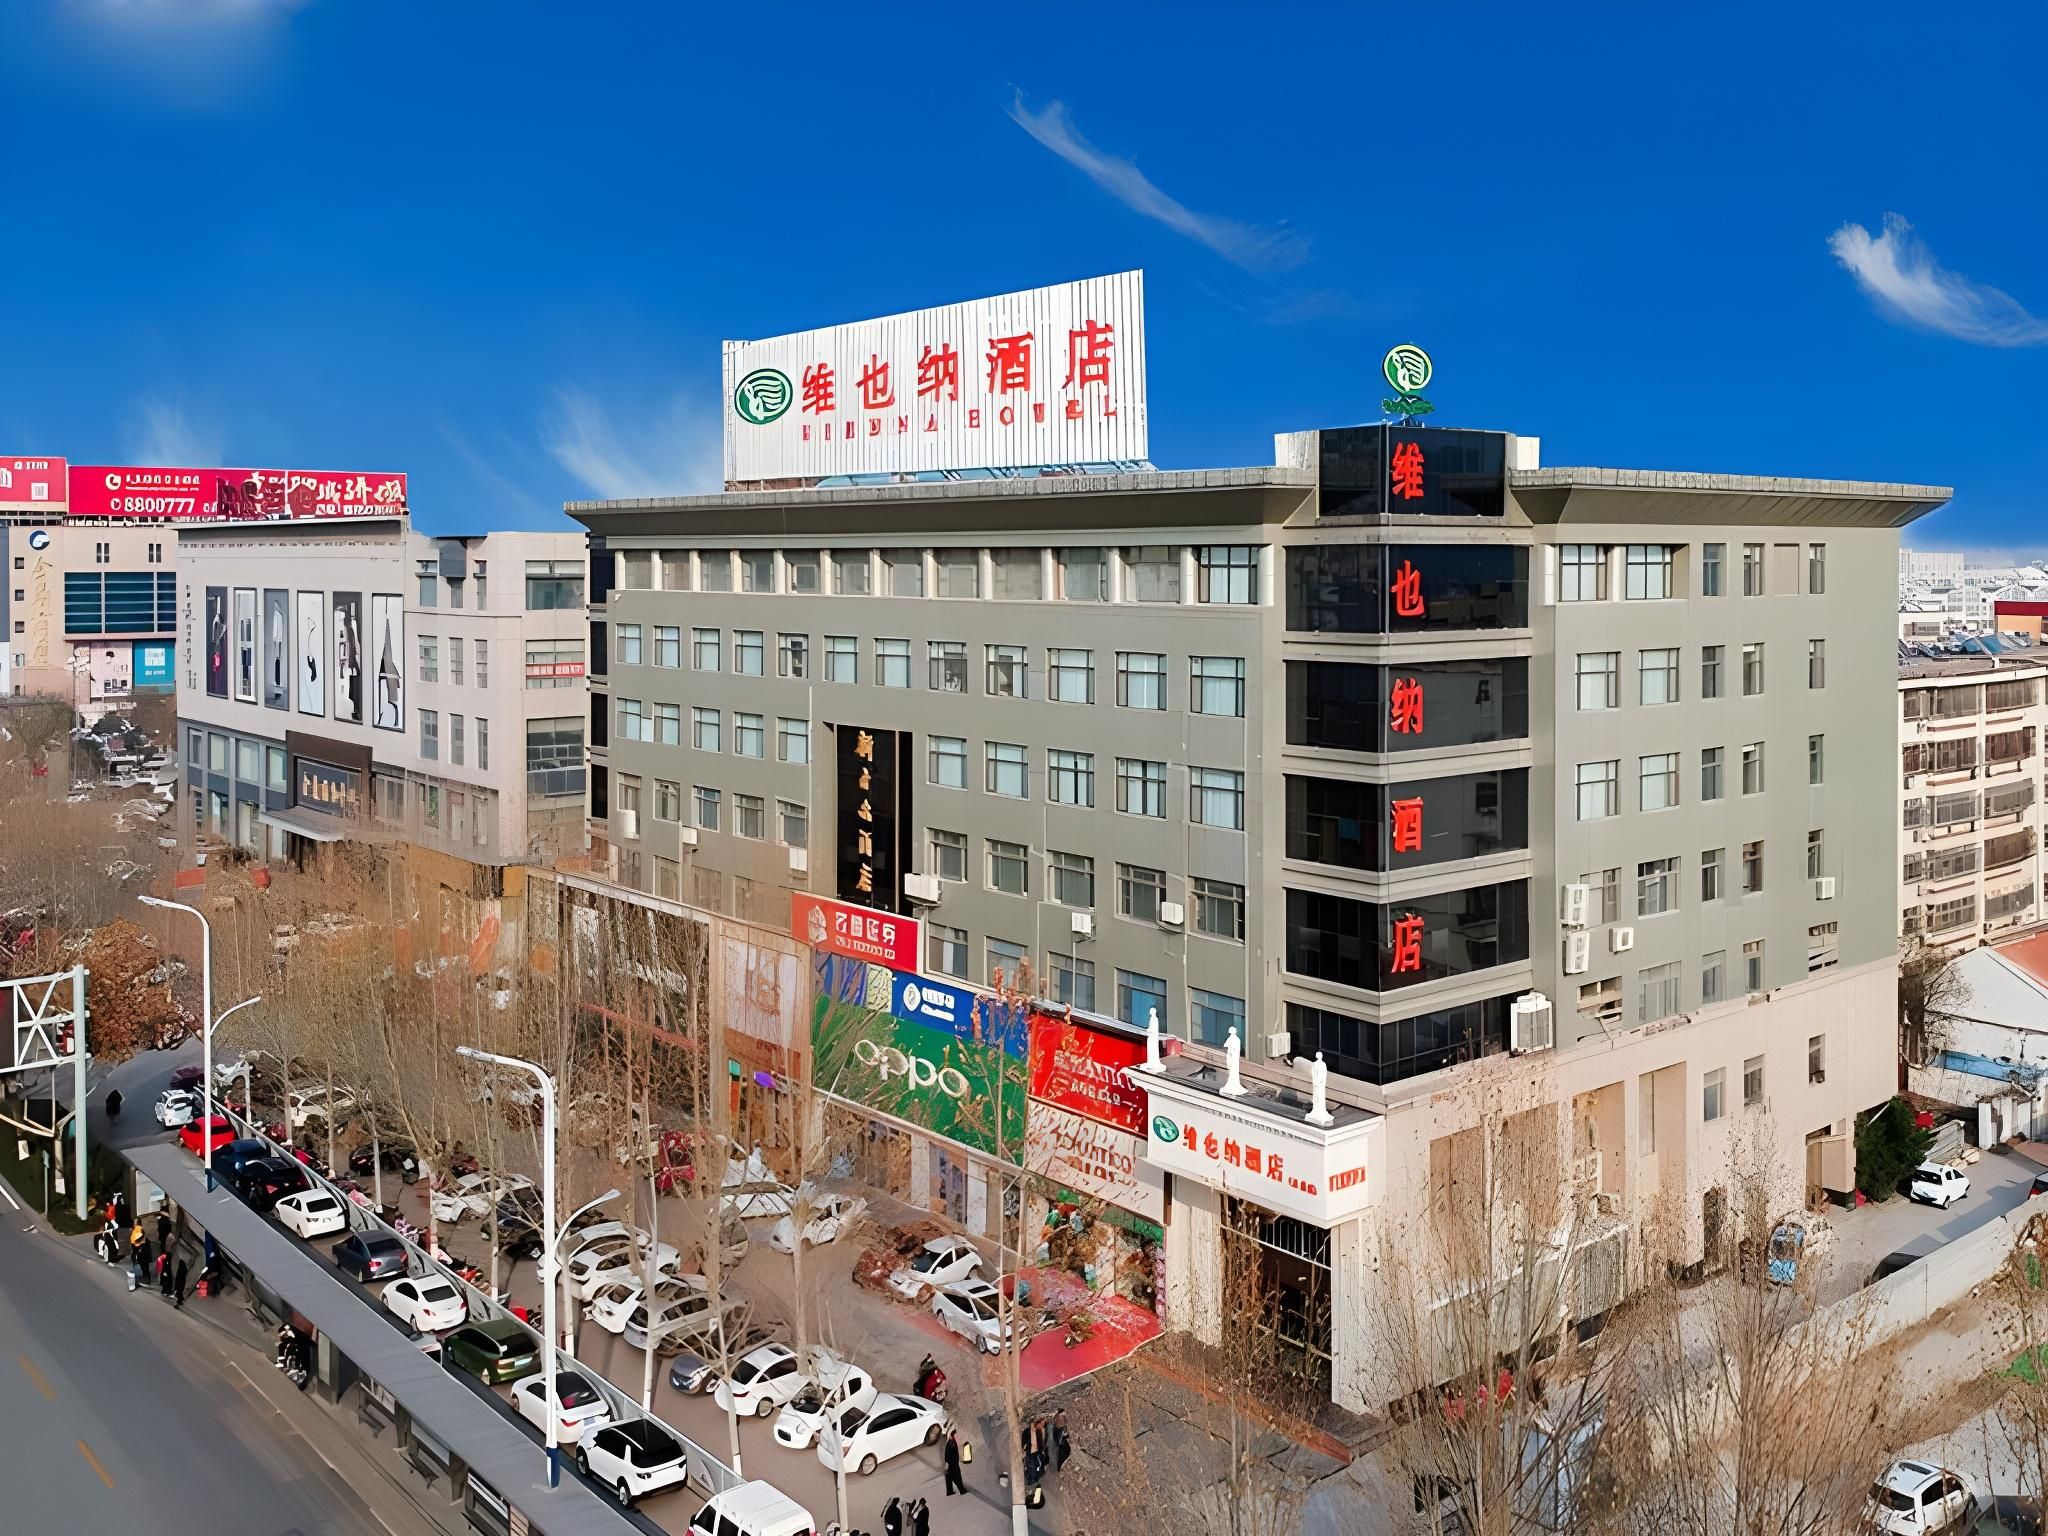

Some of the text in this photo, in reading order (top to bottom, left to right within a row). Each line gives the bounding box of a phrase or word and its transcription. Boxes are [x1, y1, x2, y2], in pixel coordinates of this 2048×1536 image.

[801, 319, 1115, 415] 维也纳酒店
[1390, 441, 1426, 974] 维也纳酒店
